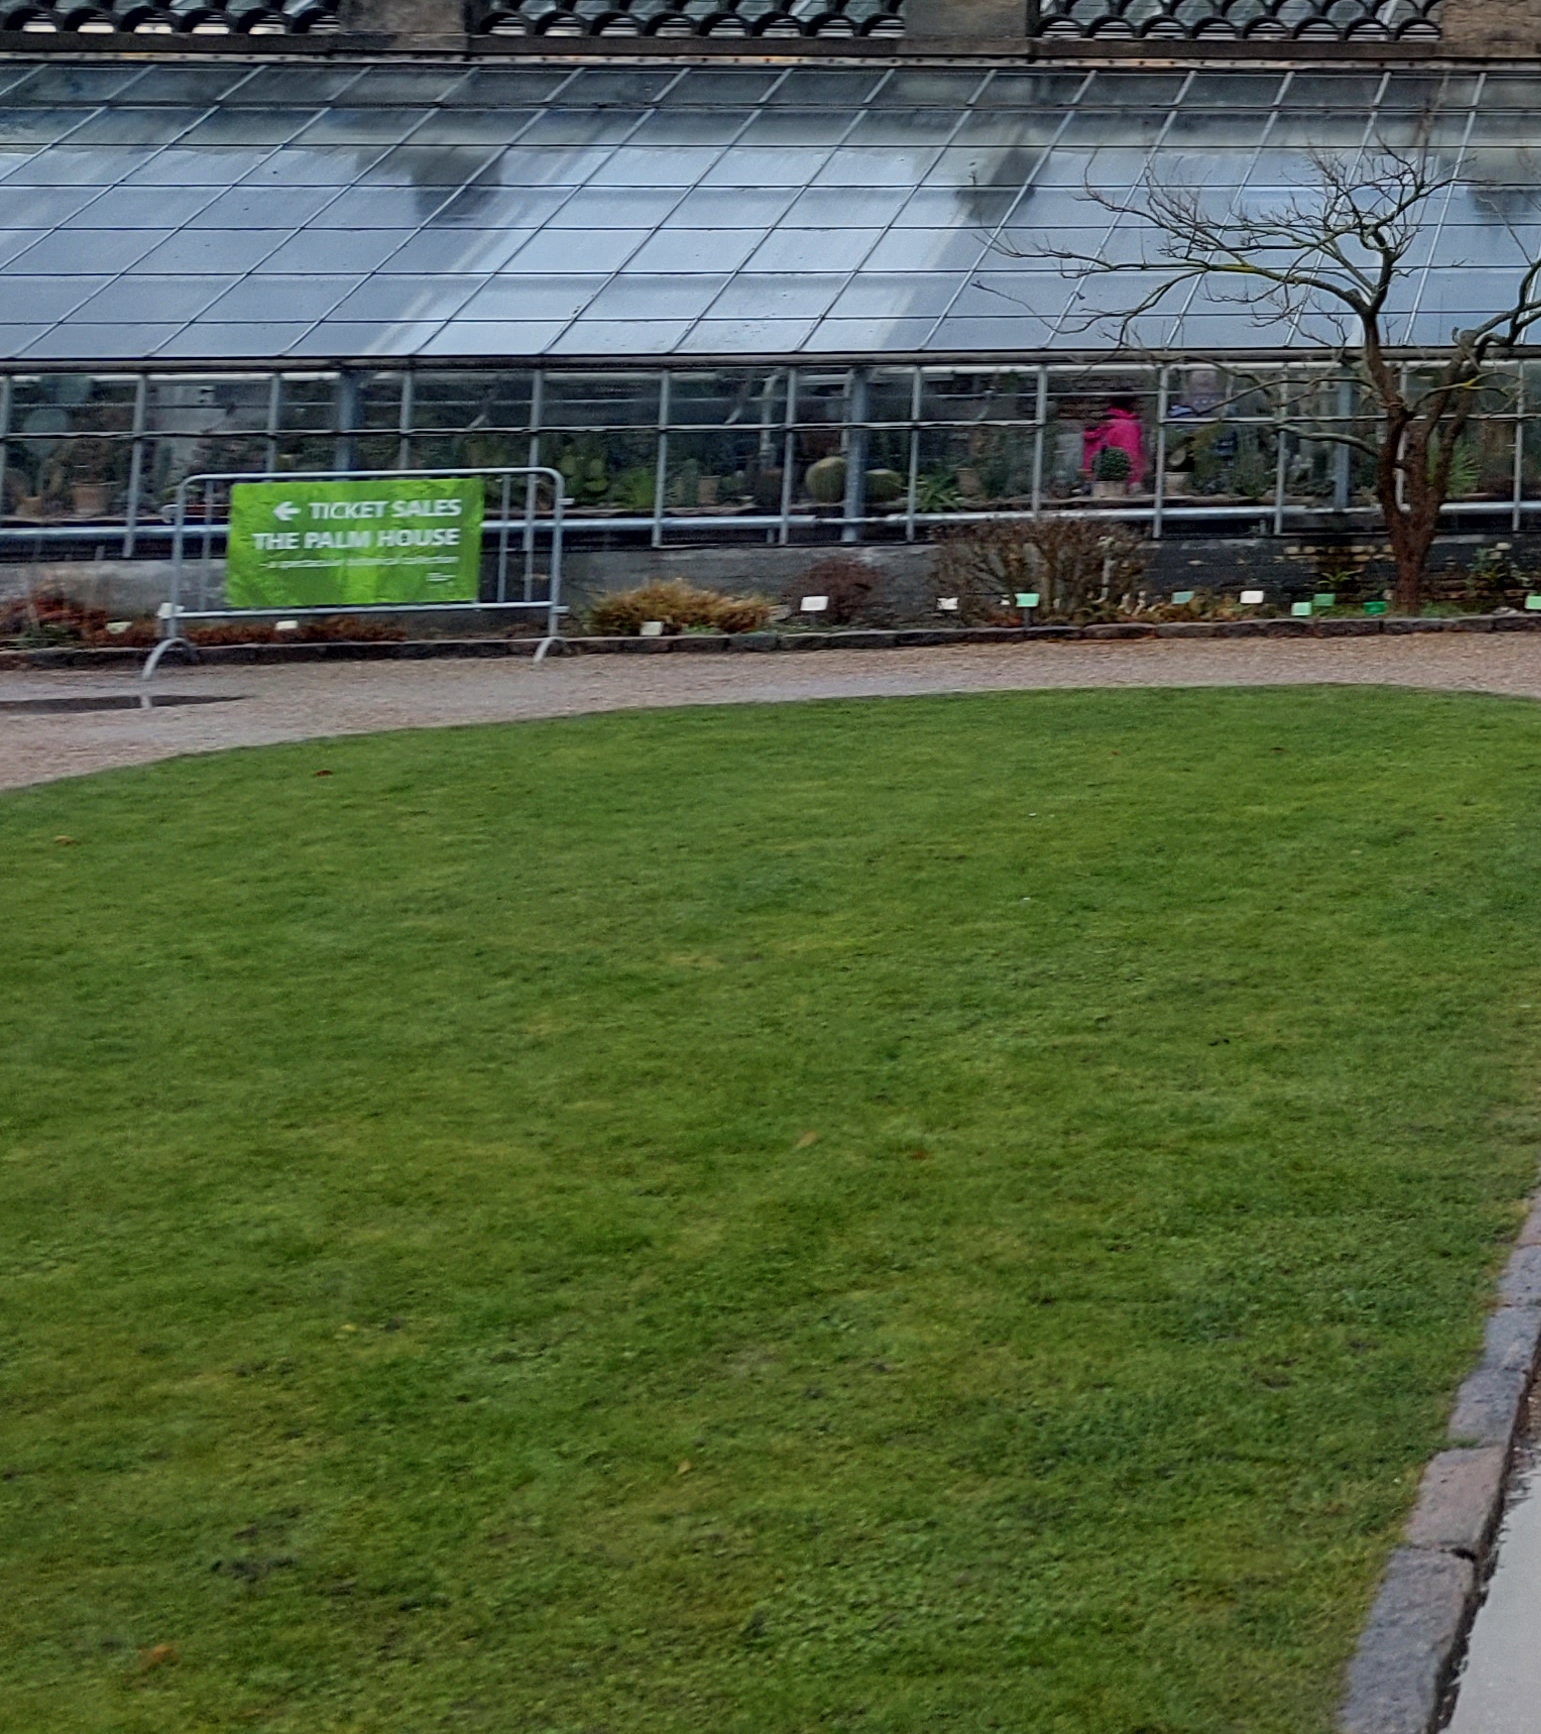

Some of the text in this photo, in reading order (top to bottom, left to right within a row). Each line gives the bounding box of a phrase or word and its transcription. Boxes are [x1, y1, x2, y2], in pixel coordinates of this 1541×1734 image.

[308, 498, 463, 520] TICKET SALES
[252, 528, 461, 550] THE PALM HOUSE
